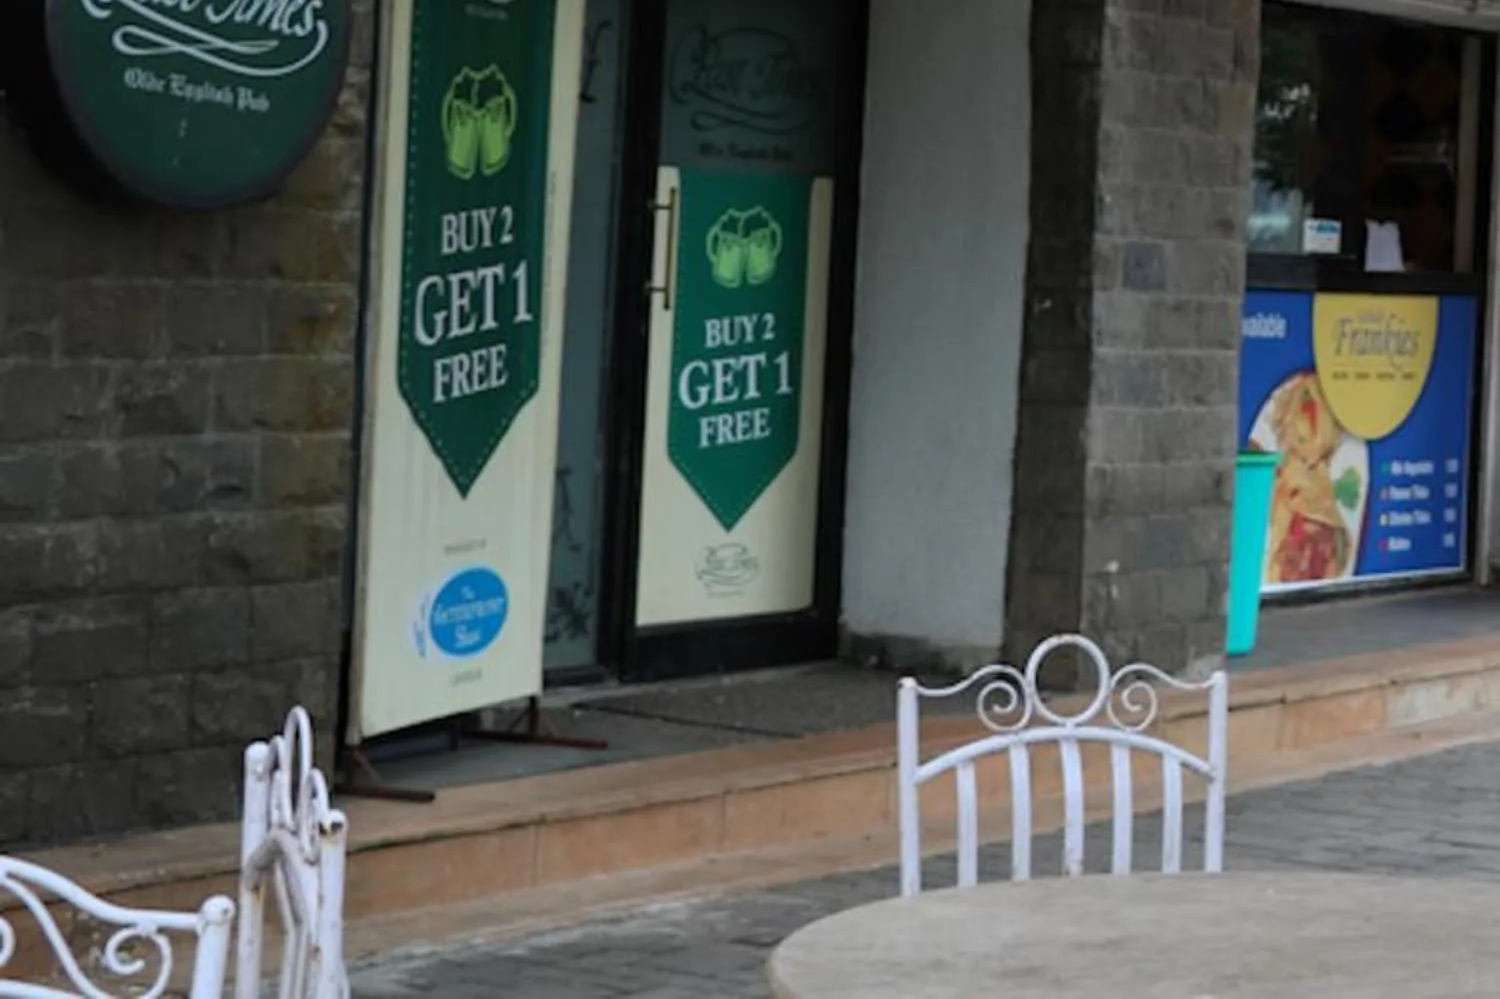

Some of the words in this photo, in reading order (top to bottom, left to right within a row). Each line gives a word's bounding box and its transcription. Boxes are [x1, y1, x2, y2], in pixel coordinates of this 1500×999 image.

[169, 73, 234, 107] English
[236, 86, 270, 111] Pub
[441, 206, 497, 256] BUY
[500, 205, 514, 244] 2
[414, 263, 505, 346] GET
[512, 259, 533, 324] 1
[704, 313, 759, 348] BUY
[762, 312, 775, 340] 2
[432, 343, 509, 403] FREE
[678, 353, 766, 409] GET
[773, 351, 793, 395] 1
[698, 407, 771, 448] FREE
